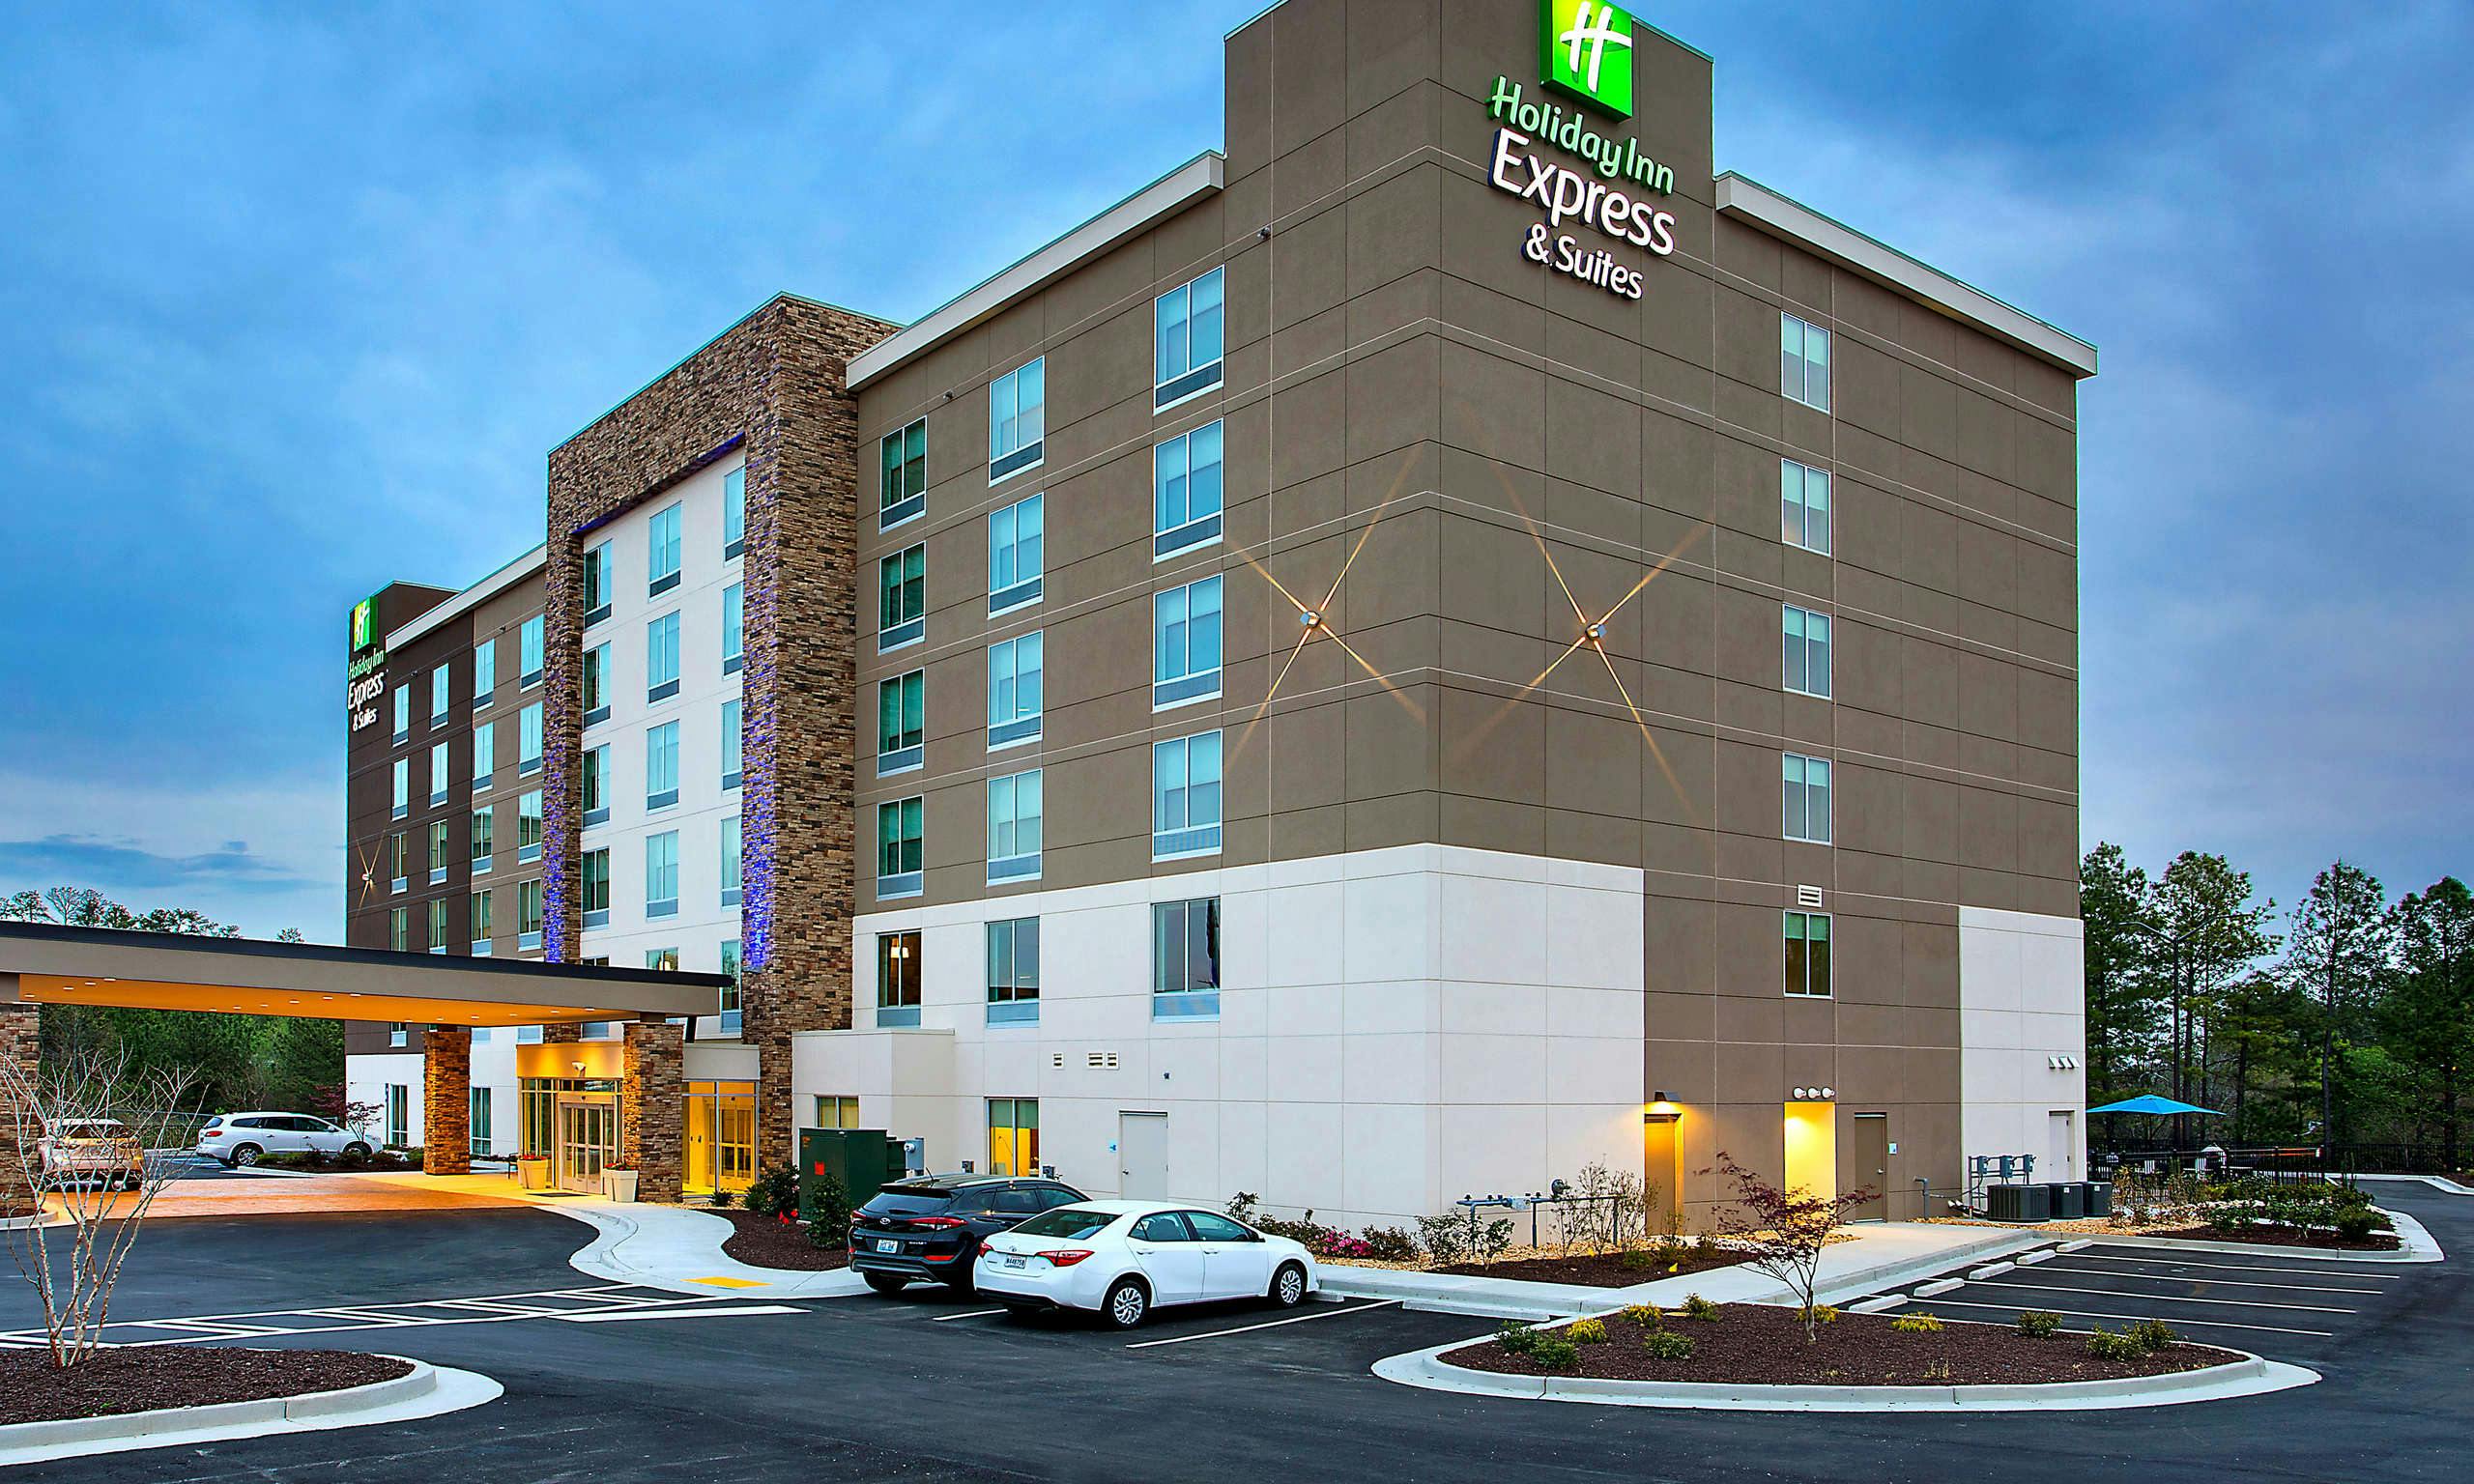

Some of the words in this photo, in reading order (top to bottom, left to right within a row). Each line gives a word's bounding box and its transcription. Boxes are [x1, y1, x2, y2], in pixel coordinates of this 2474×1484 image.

[1489, 75, 1623, 178] Holiday
[1625, 137, 1675, 194] Inn
[1489, 128, 1676, 256] Express
[1524, 223, 1551, 265] &
[1554, 235, 1644, 300] Suites
[348, 671, 385, 712] Express
[349, 654, 373, 681] Holiday
[373, 647, 385, 668] Inn
[359, 707, 378, 729] Suites
